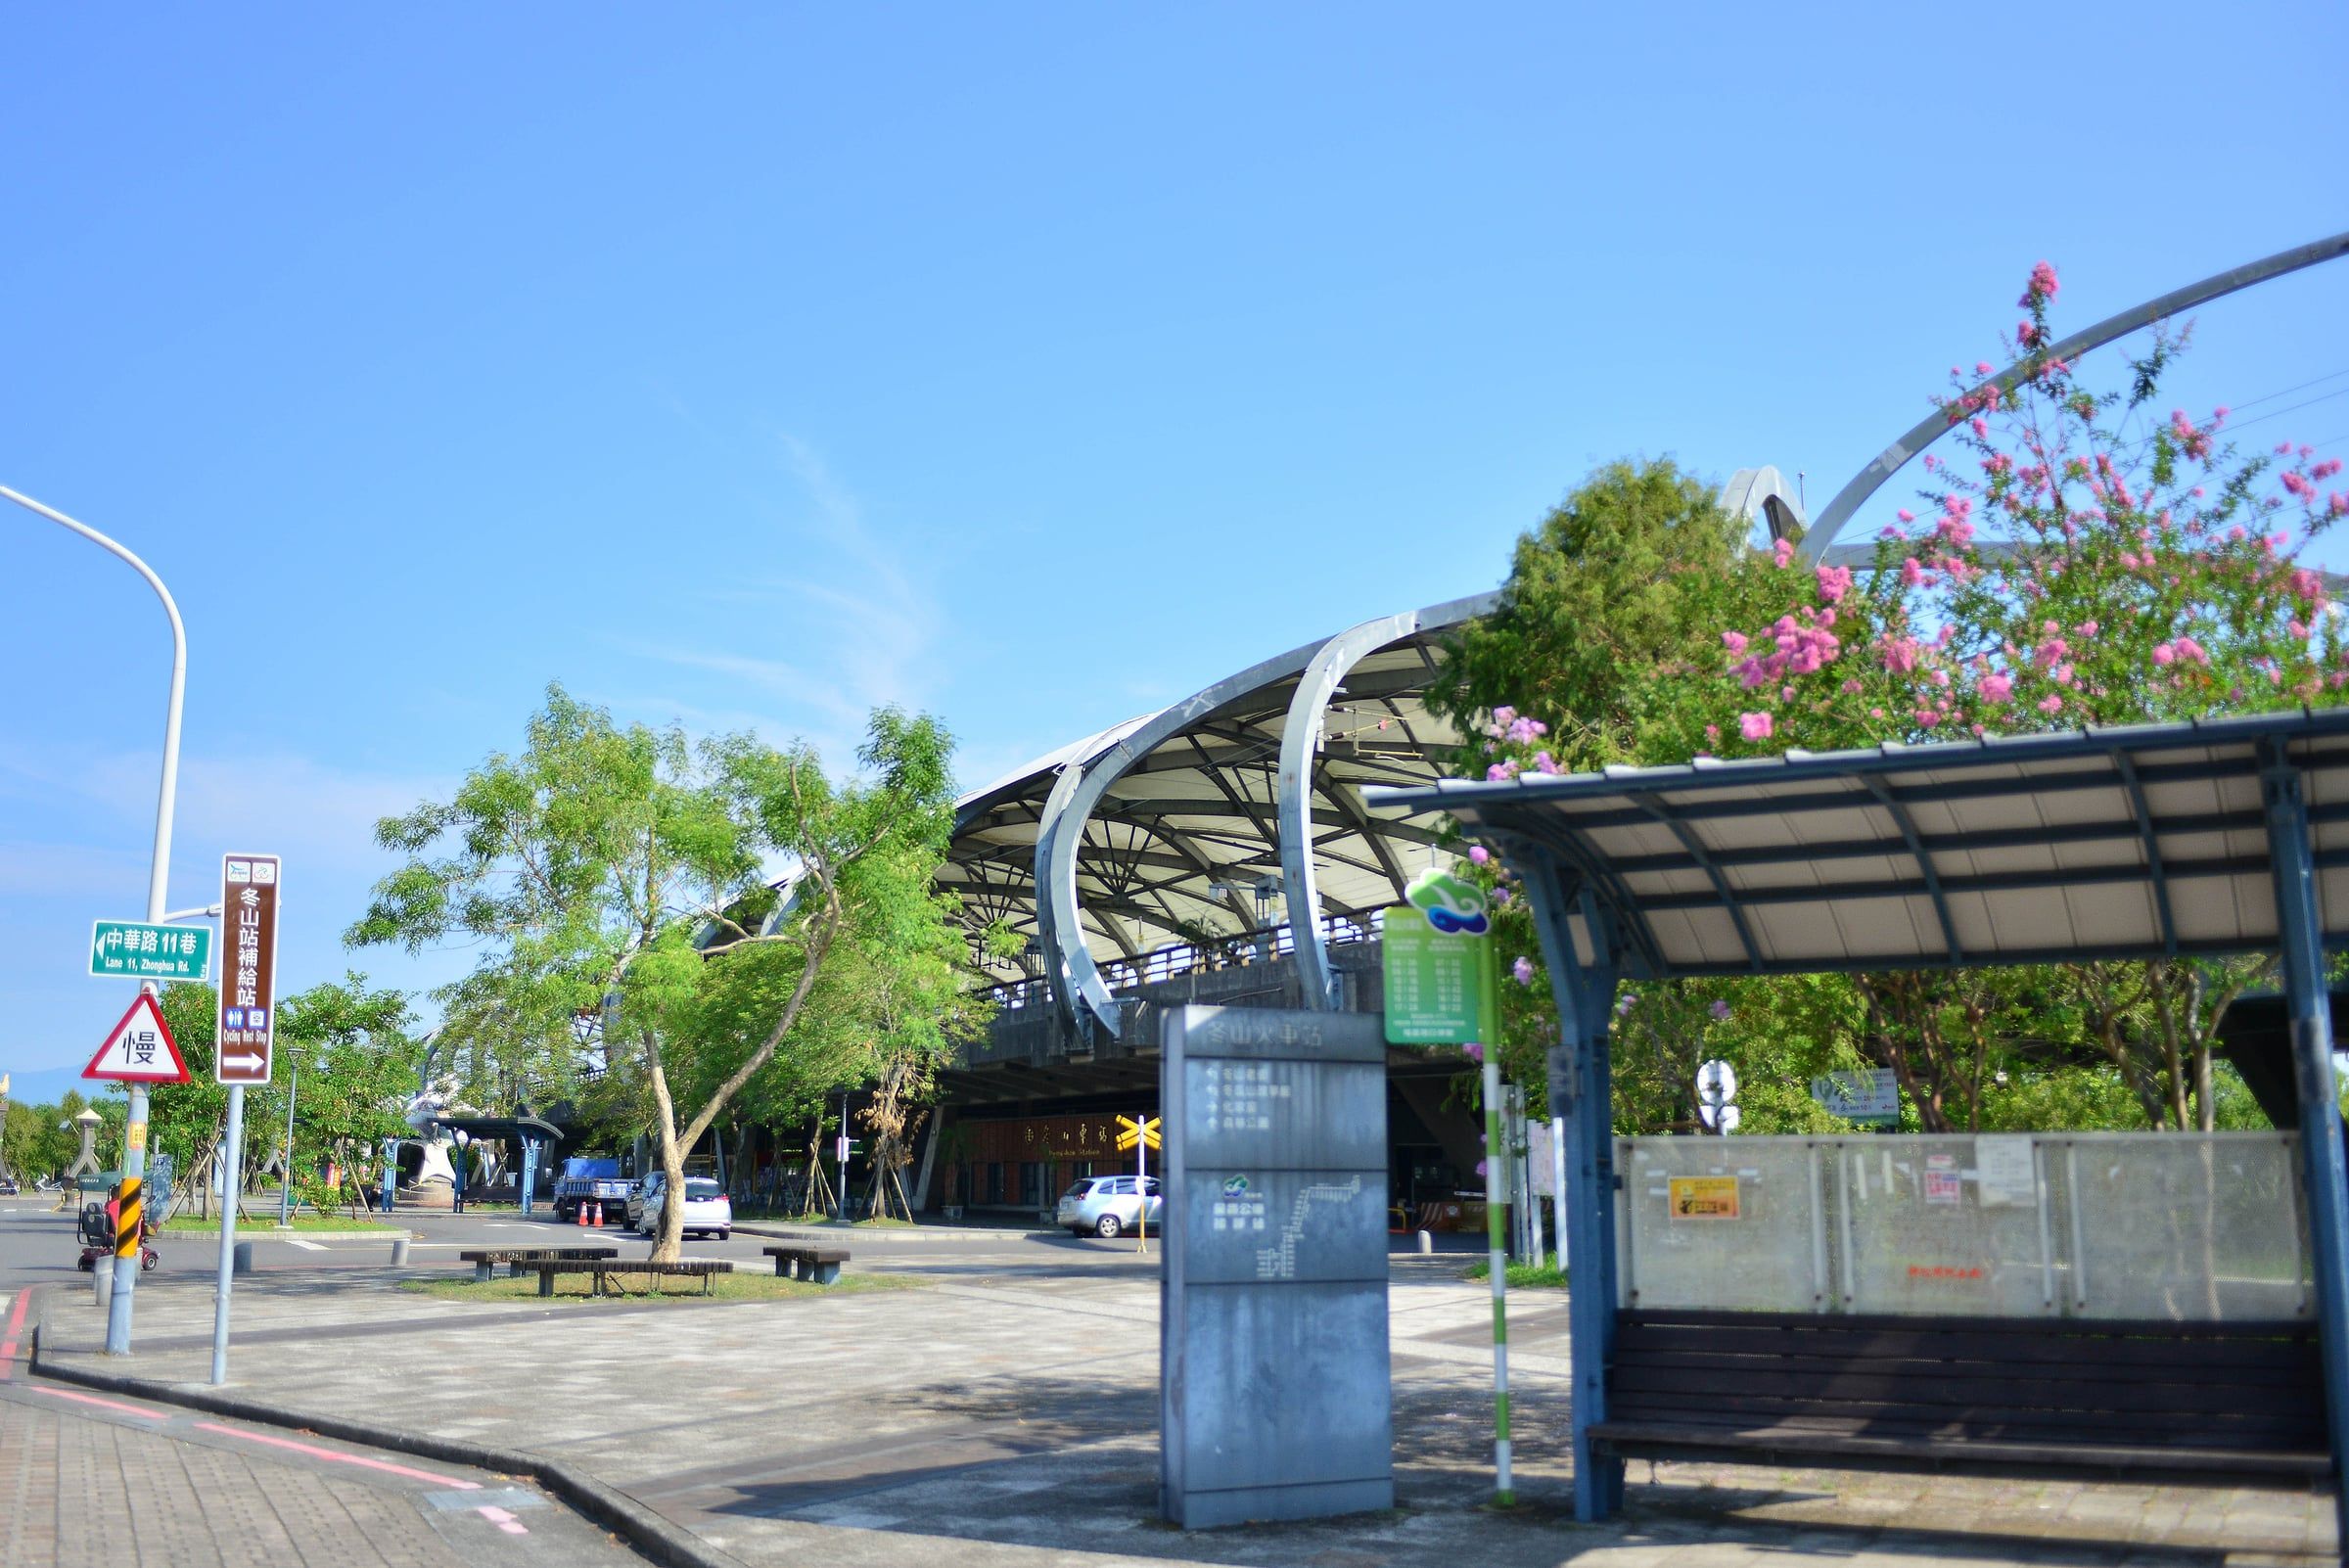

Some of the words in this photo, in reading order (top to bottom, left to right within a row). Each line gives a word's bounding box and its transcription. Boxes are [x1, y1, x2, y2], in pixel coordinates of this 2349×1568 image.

[107, 928, 197, 954] 中華路11巷
[237, 888, 260, 1007] 冬山站補給站
[106, 956, 123, 968] Lane
[127, 958, 138, 971] 11,
[141, 959, 175, 973] Zhonghua
[178, 961, 190, 972] Rd.
[122, 1031, 156, 1065] 慢
[223, 1028, 241, 1045] Cycling
[243, 1029, 254, 1042] Rest
[255, 1030, 267, 1045] Stop
